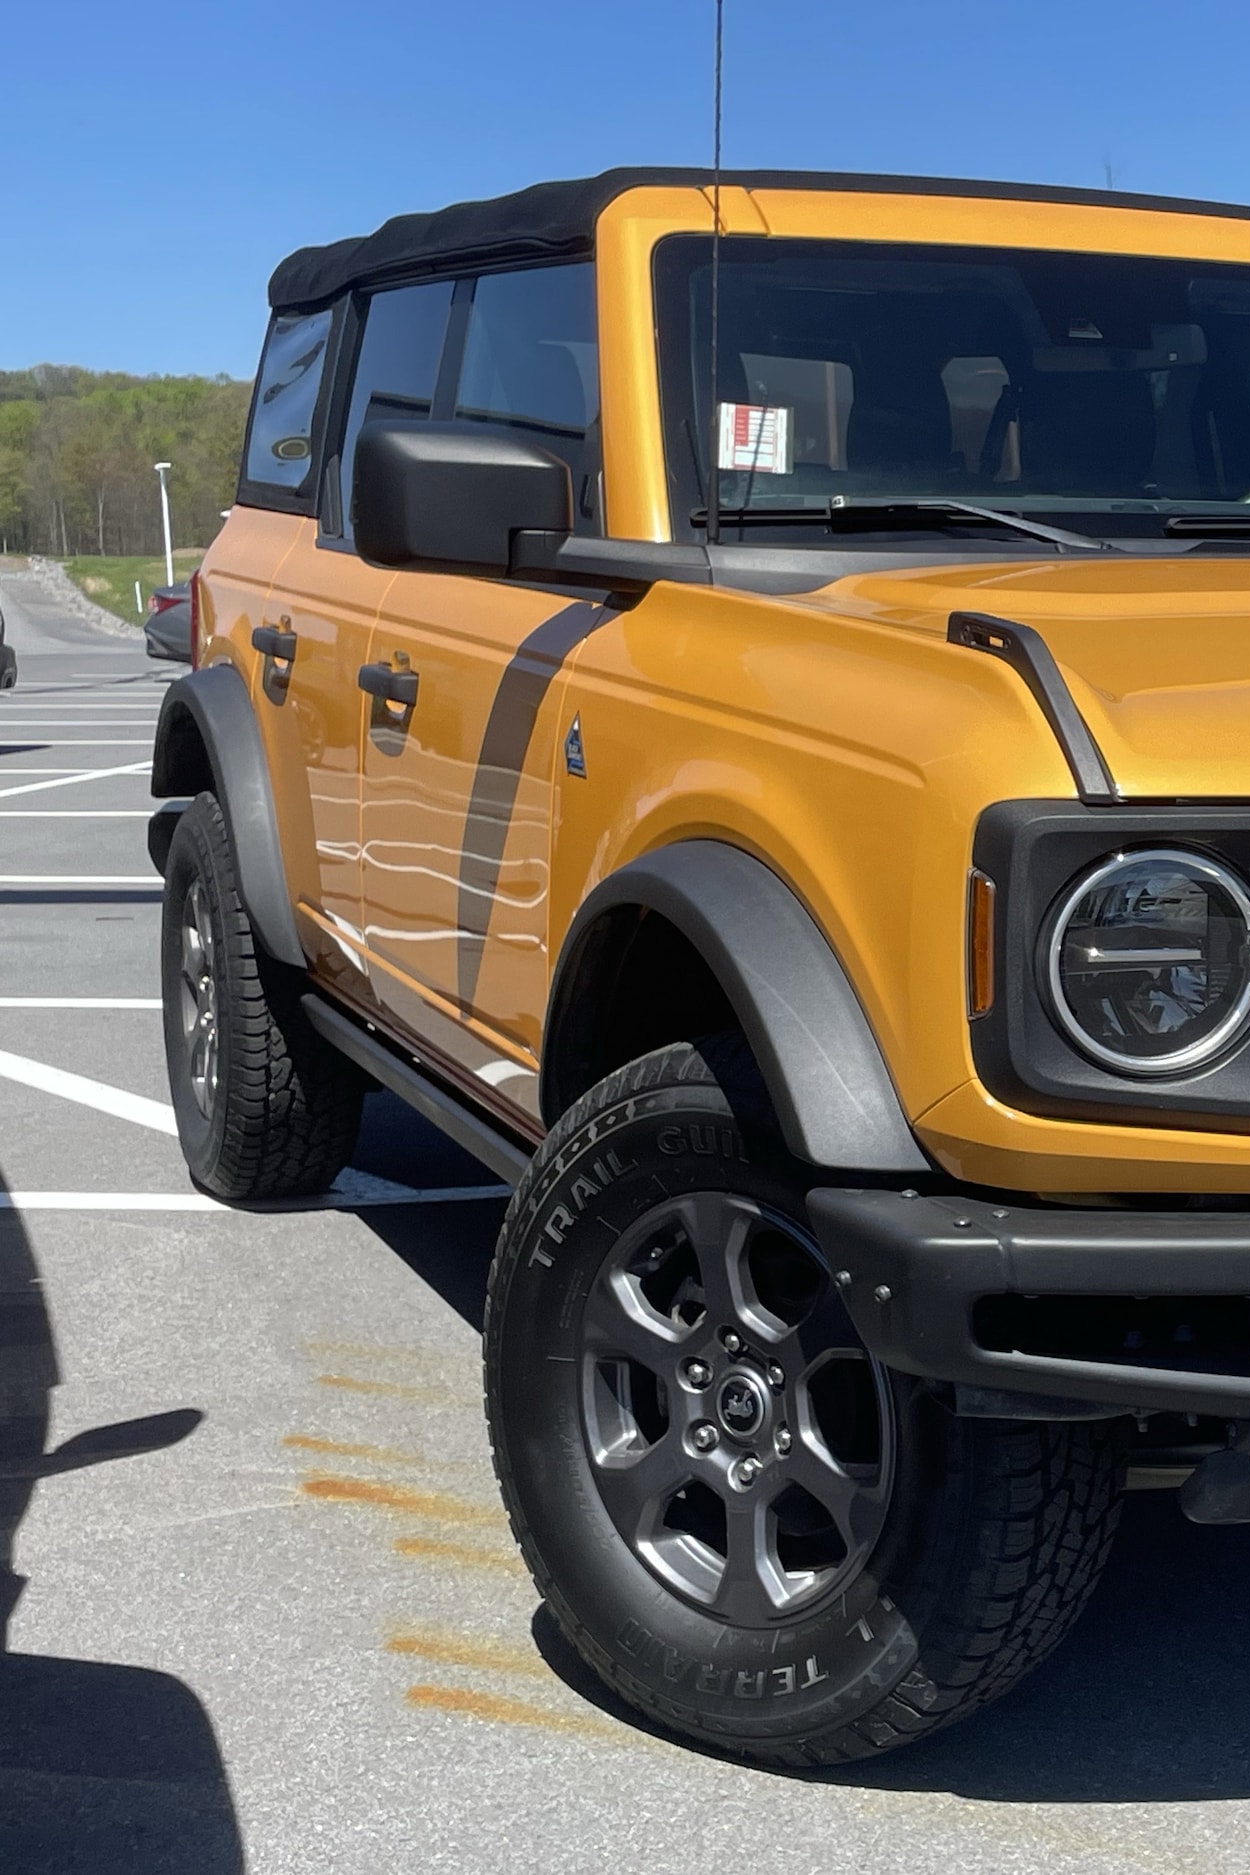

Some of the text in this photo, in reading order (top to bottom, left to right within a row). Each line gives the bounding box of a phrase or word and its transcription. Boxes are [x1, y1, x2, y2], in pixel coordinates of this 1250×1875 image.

[528, 1124, 749, 1269] TRAIL GUI
[616, 1617, 829, 1699] TERRAIN
